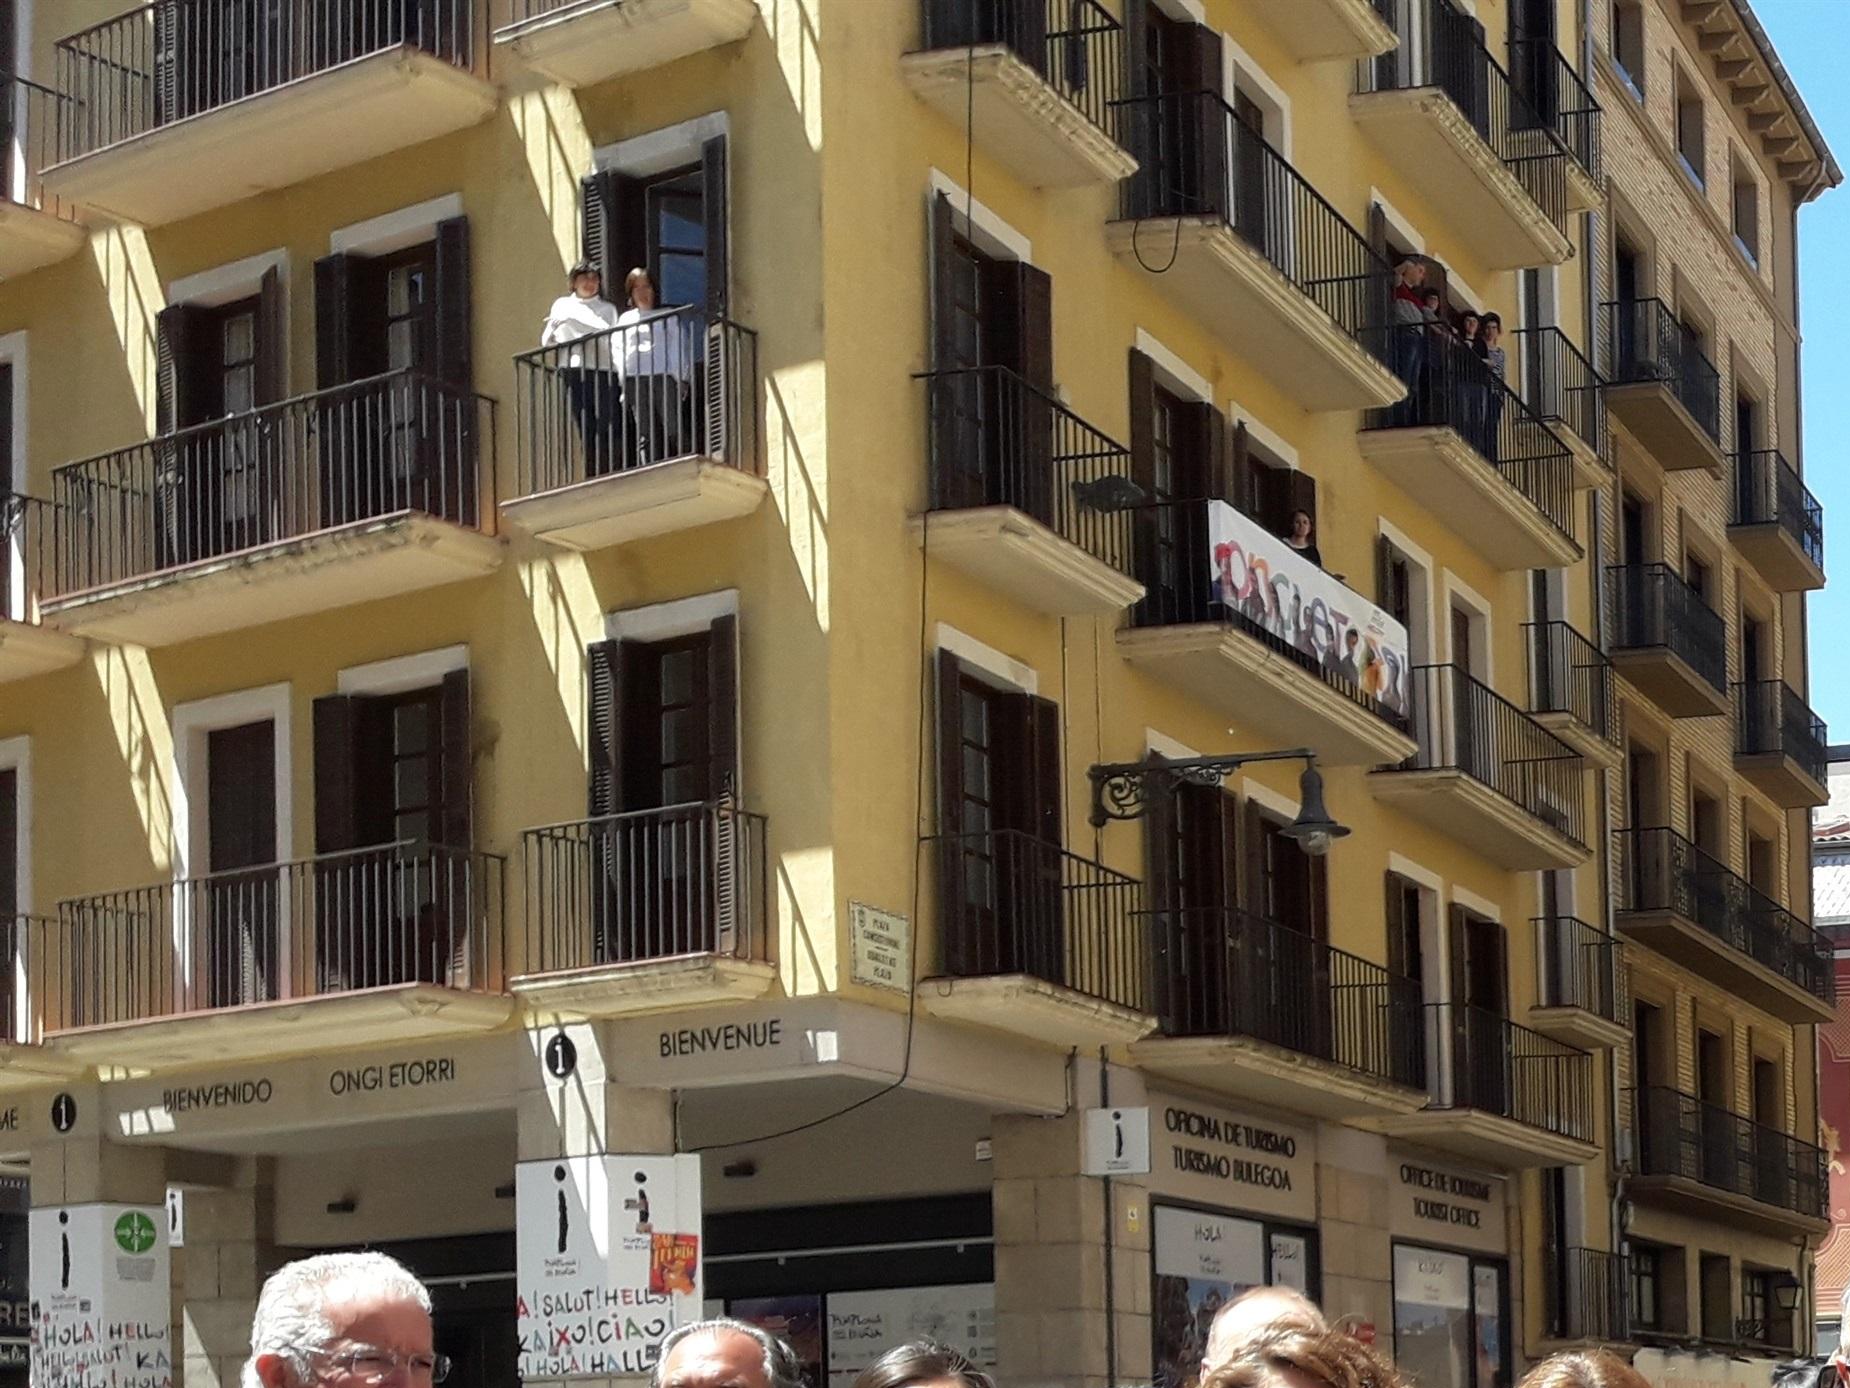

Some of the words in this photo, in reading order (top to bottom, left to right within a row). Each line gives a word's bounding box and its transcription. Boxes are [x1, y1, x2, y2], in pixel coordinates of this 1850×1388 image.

[659, 1019, 781, 1057] BIENVENUE
[163, 1078, 272, 1113] BIENVENIDO
[330, 1066, 383, 1096] ONGI
[389, 1058, 455, 1088] ETORRI
[1165, 1107, 1223, 1144] OFICINA
[1224, 1121, 1243, 1148] DE
[1242, 1125, 1296, 1159] TURISMO
[1172, 1145, 1231, 1179] TURISMO
[1233, 1159, 1292, 1191] BULEGOA
[542, 1285, 601, 1317] SALUT!
